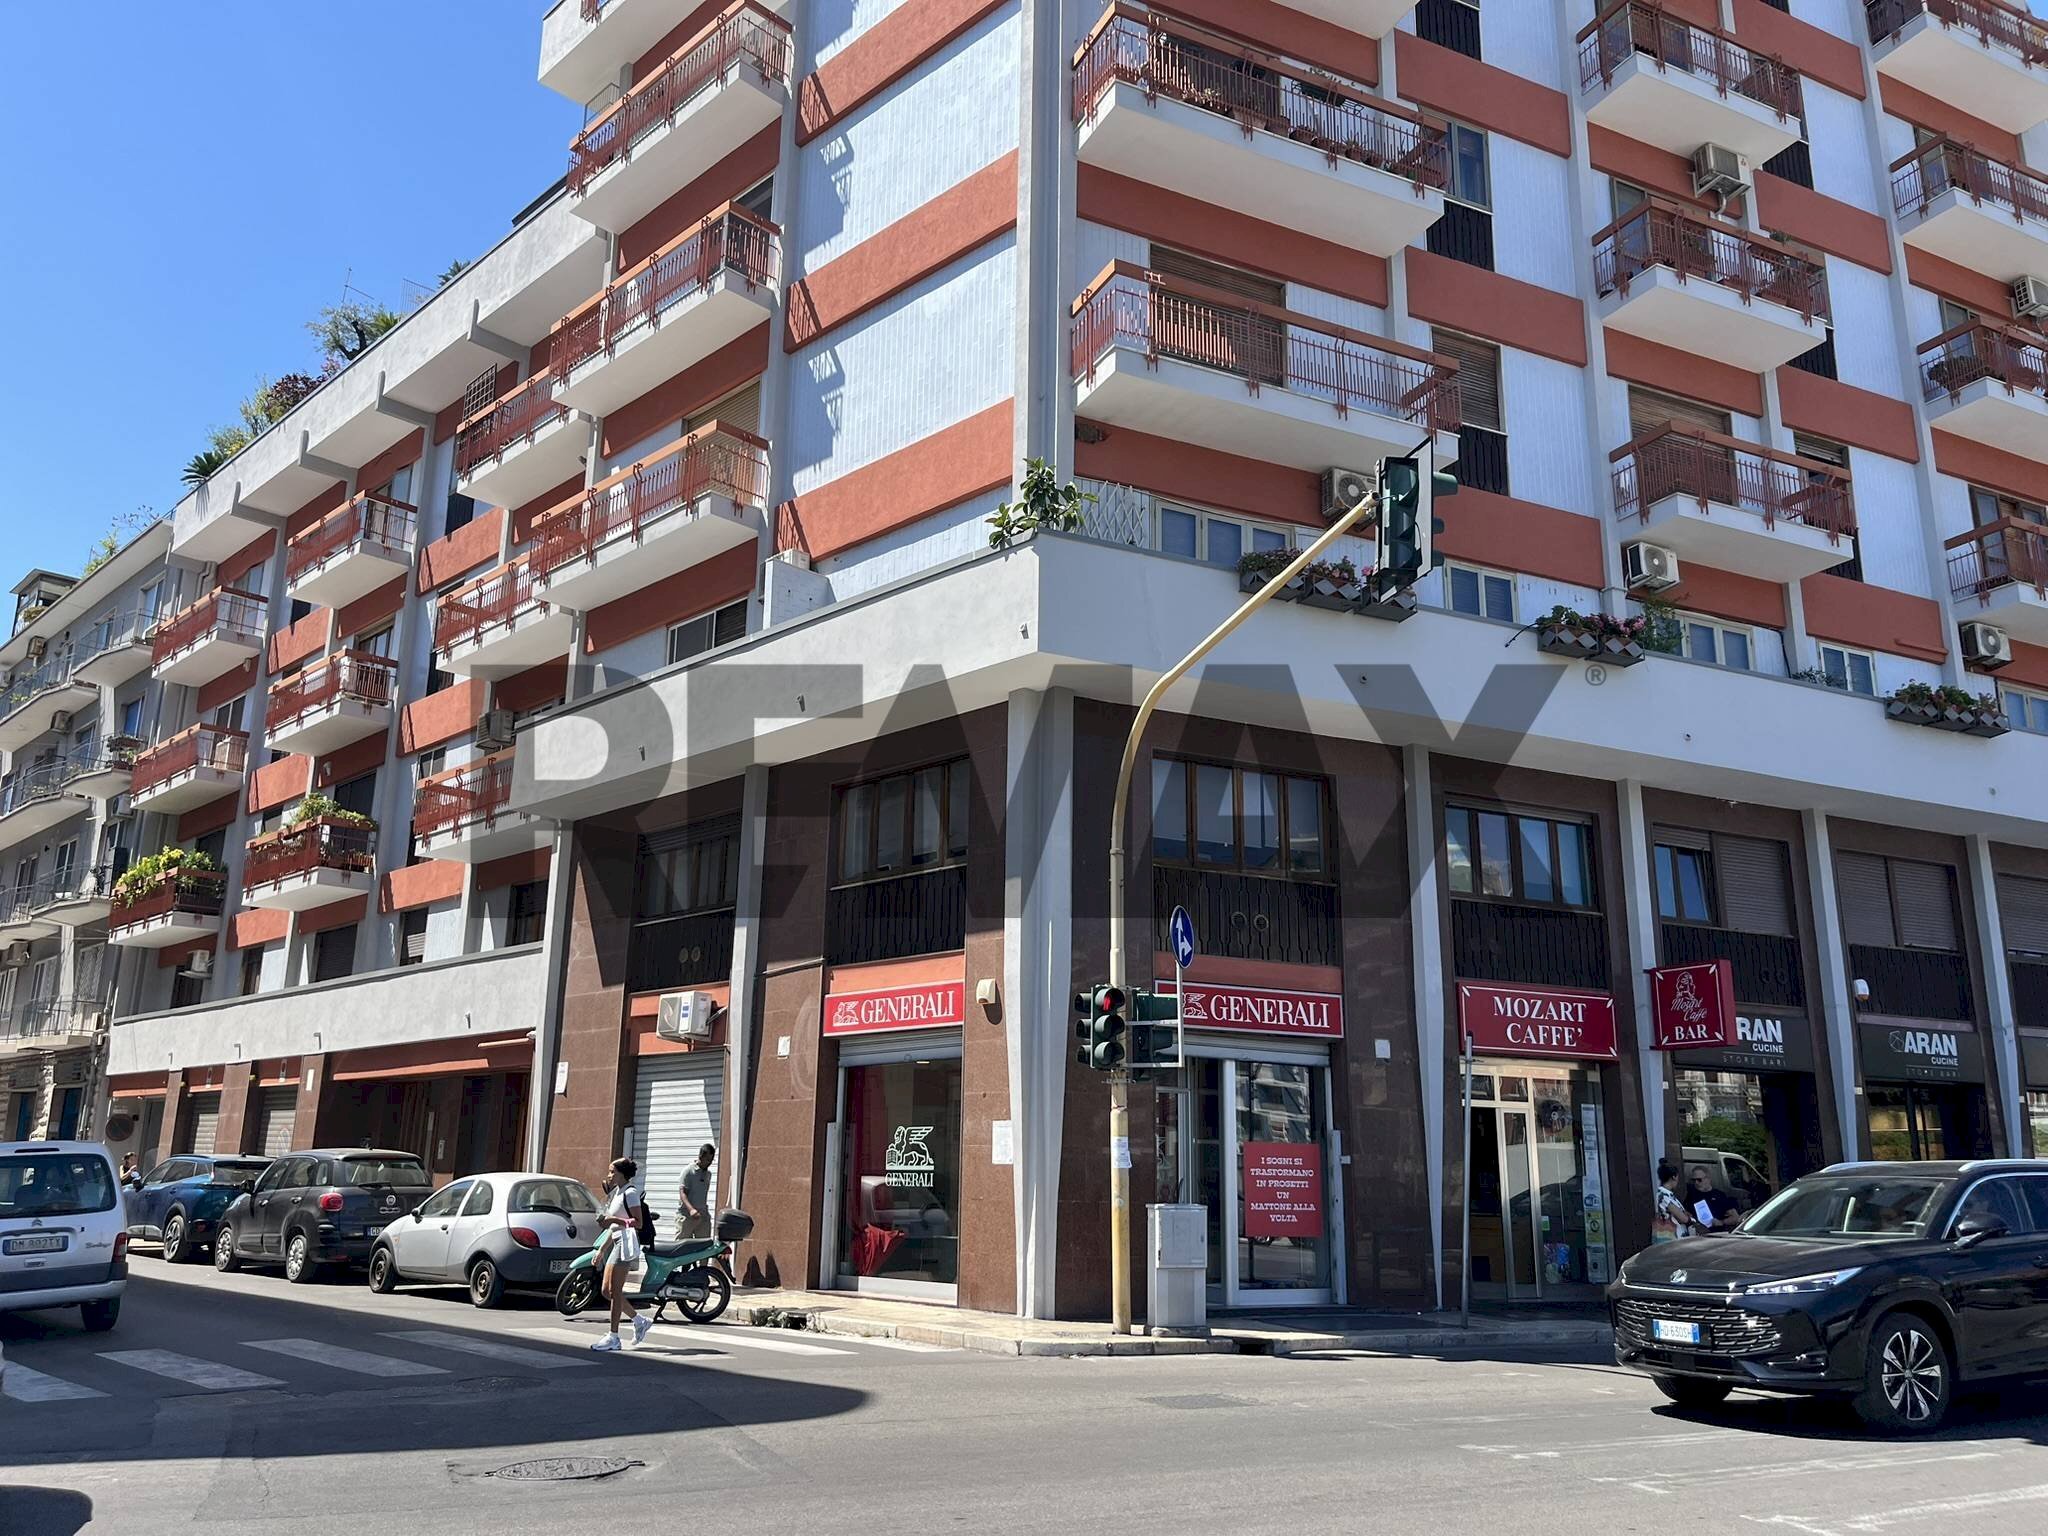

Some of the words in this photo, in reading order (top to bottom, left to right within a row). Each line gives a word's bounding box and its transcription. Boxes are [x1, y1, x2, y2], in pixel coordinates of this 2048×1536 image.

[861, 990, 955, 1024] GENERALI
[1210, 994, 1330, 1028] GENERALI
[1493, 996, 1587, 1022] MOZART
[1506, 1022, 1583, 1047] CAFFE'
[1674, 1023, 1709, 1041] BAR
[1736, 1016, 1783, 1043] RAN
[1752, 1043, 1784, 1054] CUCINE
[1904, 1031, 1958, 1057] ARAN
[1931, 1056, 1959, 1067] CUCINE
[1266, 1157, 1293, 1166] SOGNI
[1294, 1158, 1303, 1166] SI
[1250, 1168, 1315, 1177] TRASFORMANO
[885, 1172, 934, 1187] GENERALI
[1256, 1180, 1267, 1188] IN
[1268, 1180, 1309, 1188] PROGETTI
[1276, 1191, 1290, 1200] UN
[1250, 1202, 1292, 1211] MATTONE
[1293, 1203, 1316, 1211] ALLA
[1269, 1214, 1298, 1222] VOLTA
